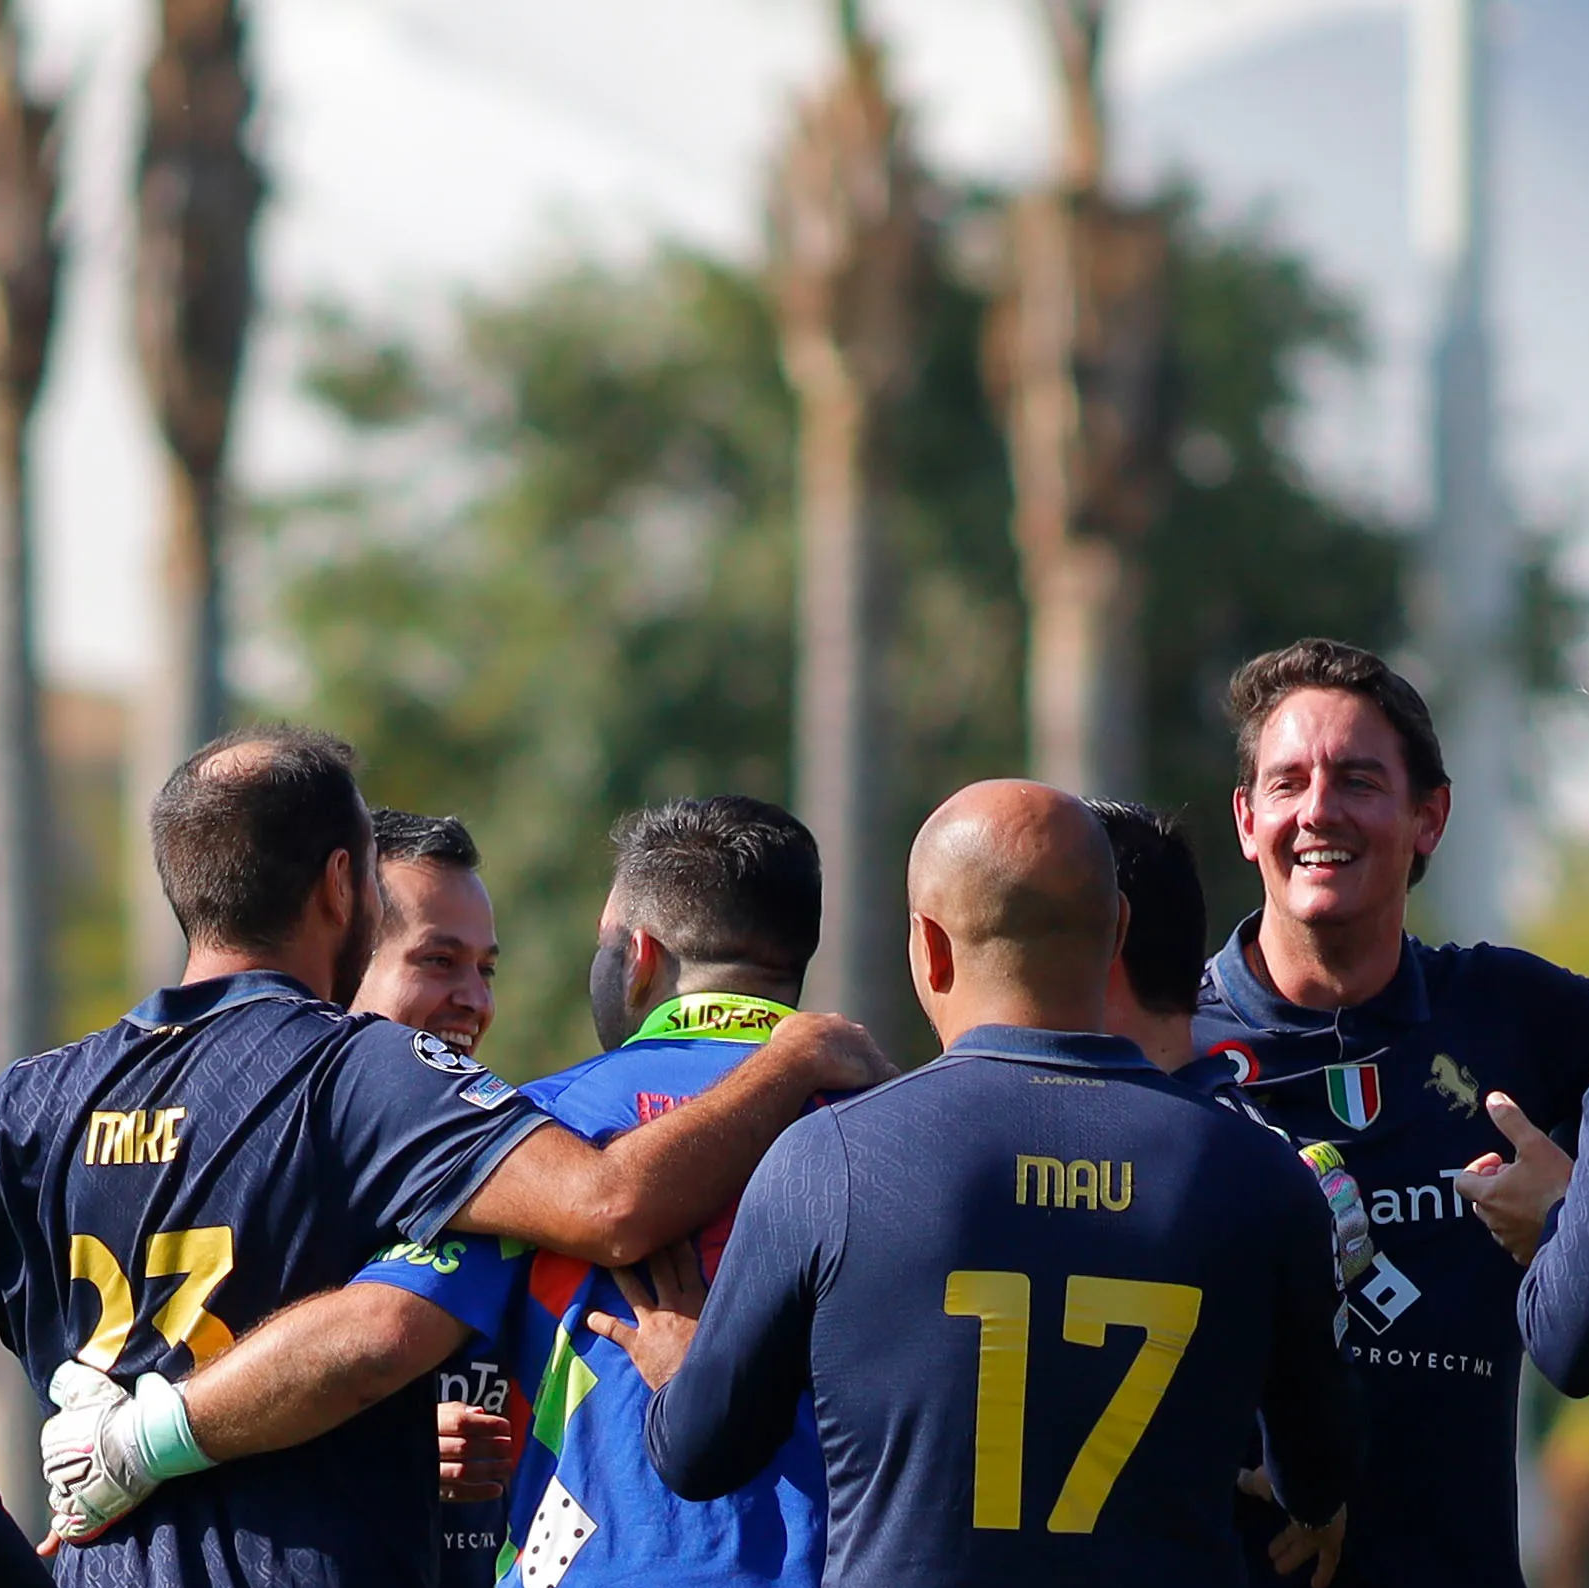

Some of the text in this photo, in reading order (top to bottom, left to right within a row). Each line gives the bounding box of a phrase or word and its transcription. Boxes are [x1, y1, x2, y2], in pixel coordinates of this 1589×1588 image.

[85, 1106, 187, 1165] MIKE
[1015, 1154, 1134, 1212] MAU
[1370, 1169, 1465, 1225] anT
[944, 1270, 1203, 1534] 17
